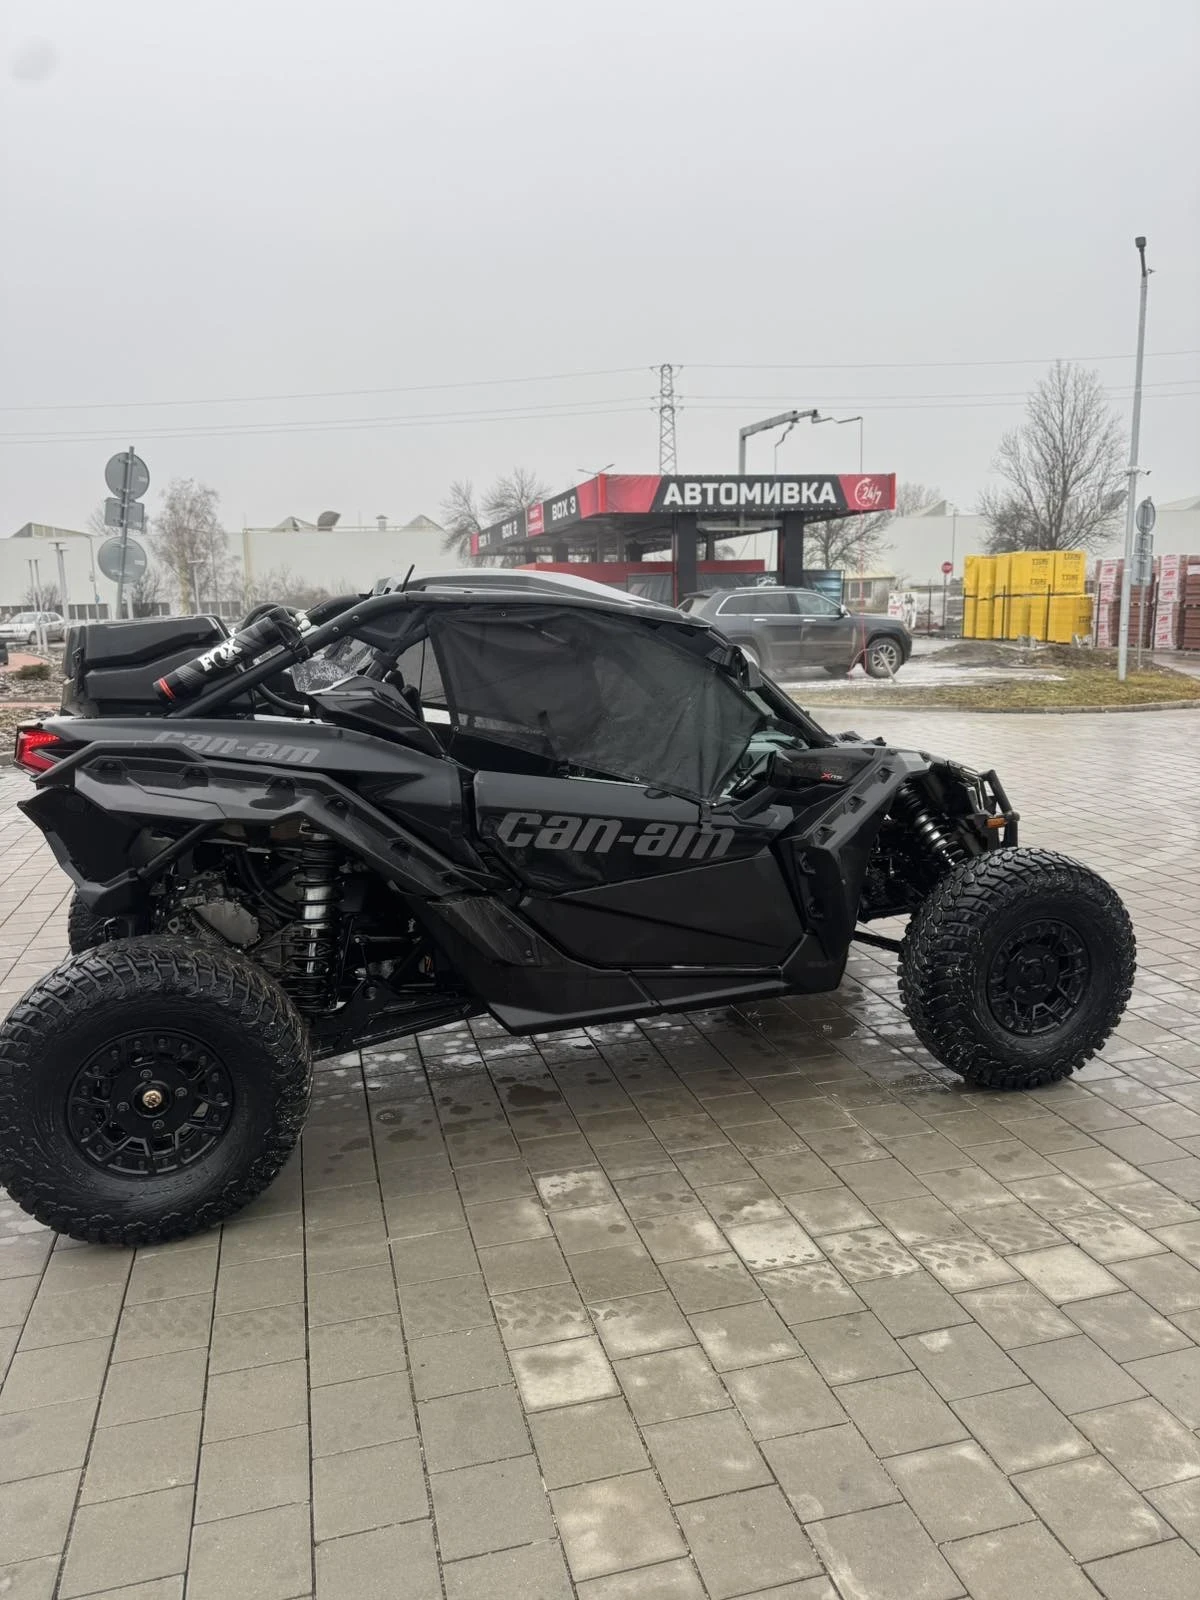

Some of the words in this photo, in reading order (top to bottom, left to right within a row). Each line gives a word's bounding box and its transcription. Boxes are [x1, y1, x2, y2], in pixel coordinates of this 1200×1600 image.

[663, 482, 837, 505] АВТОМИВКА
[862, 485, 882, 505] 24/7
[552, 498, 569, 520] BOX
[570, 496, 577, 514] 3
[198, 638, 242, 672] FOX
[497, 812, 736, 860] can-am
